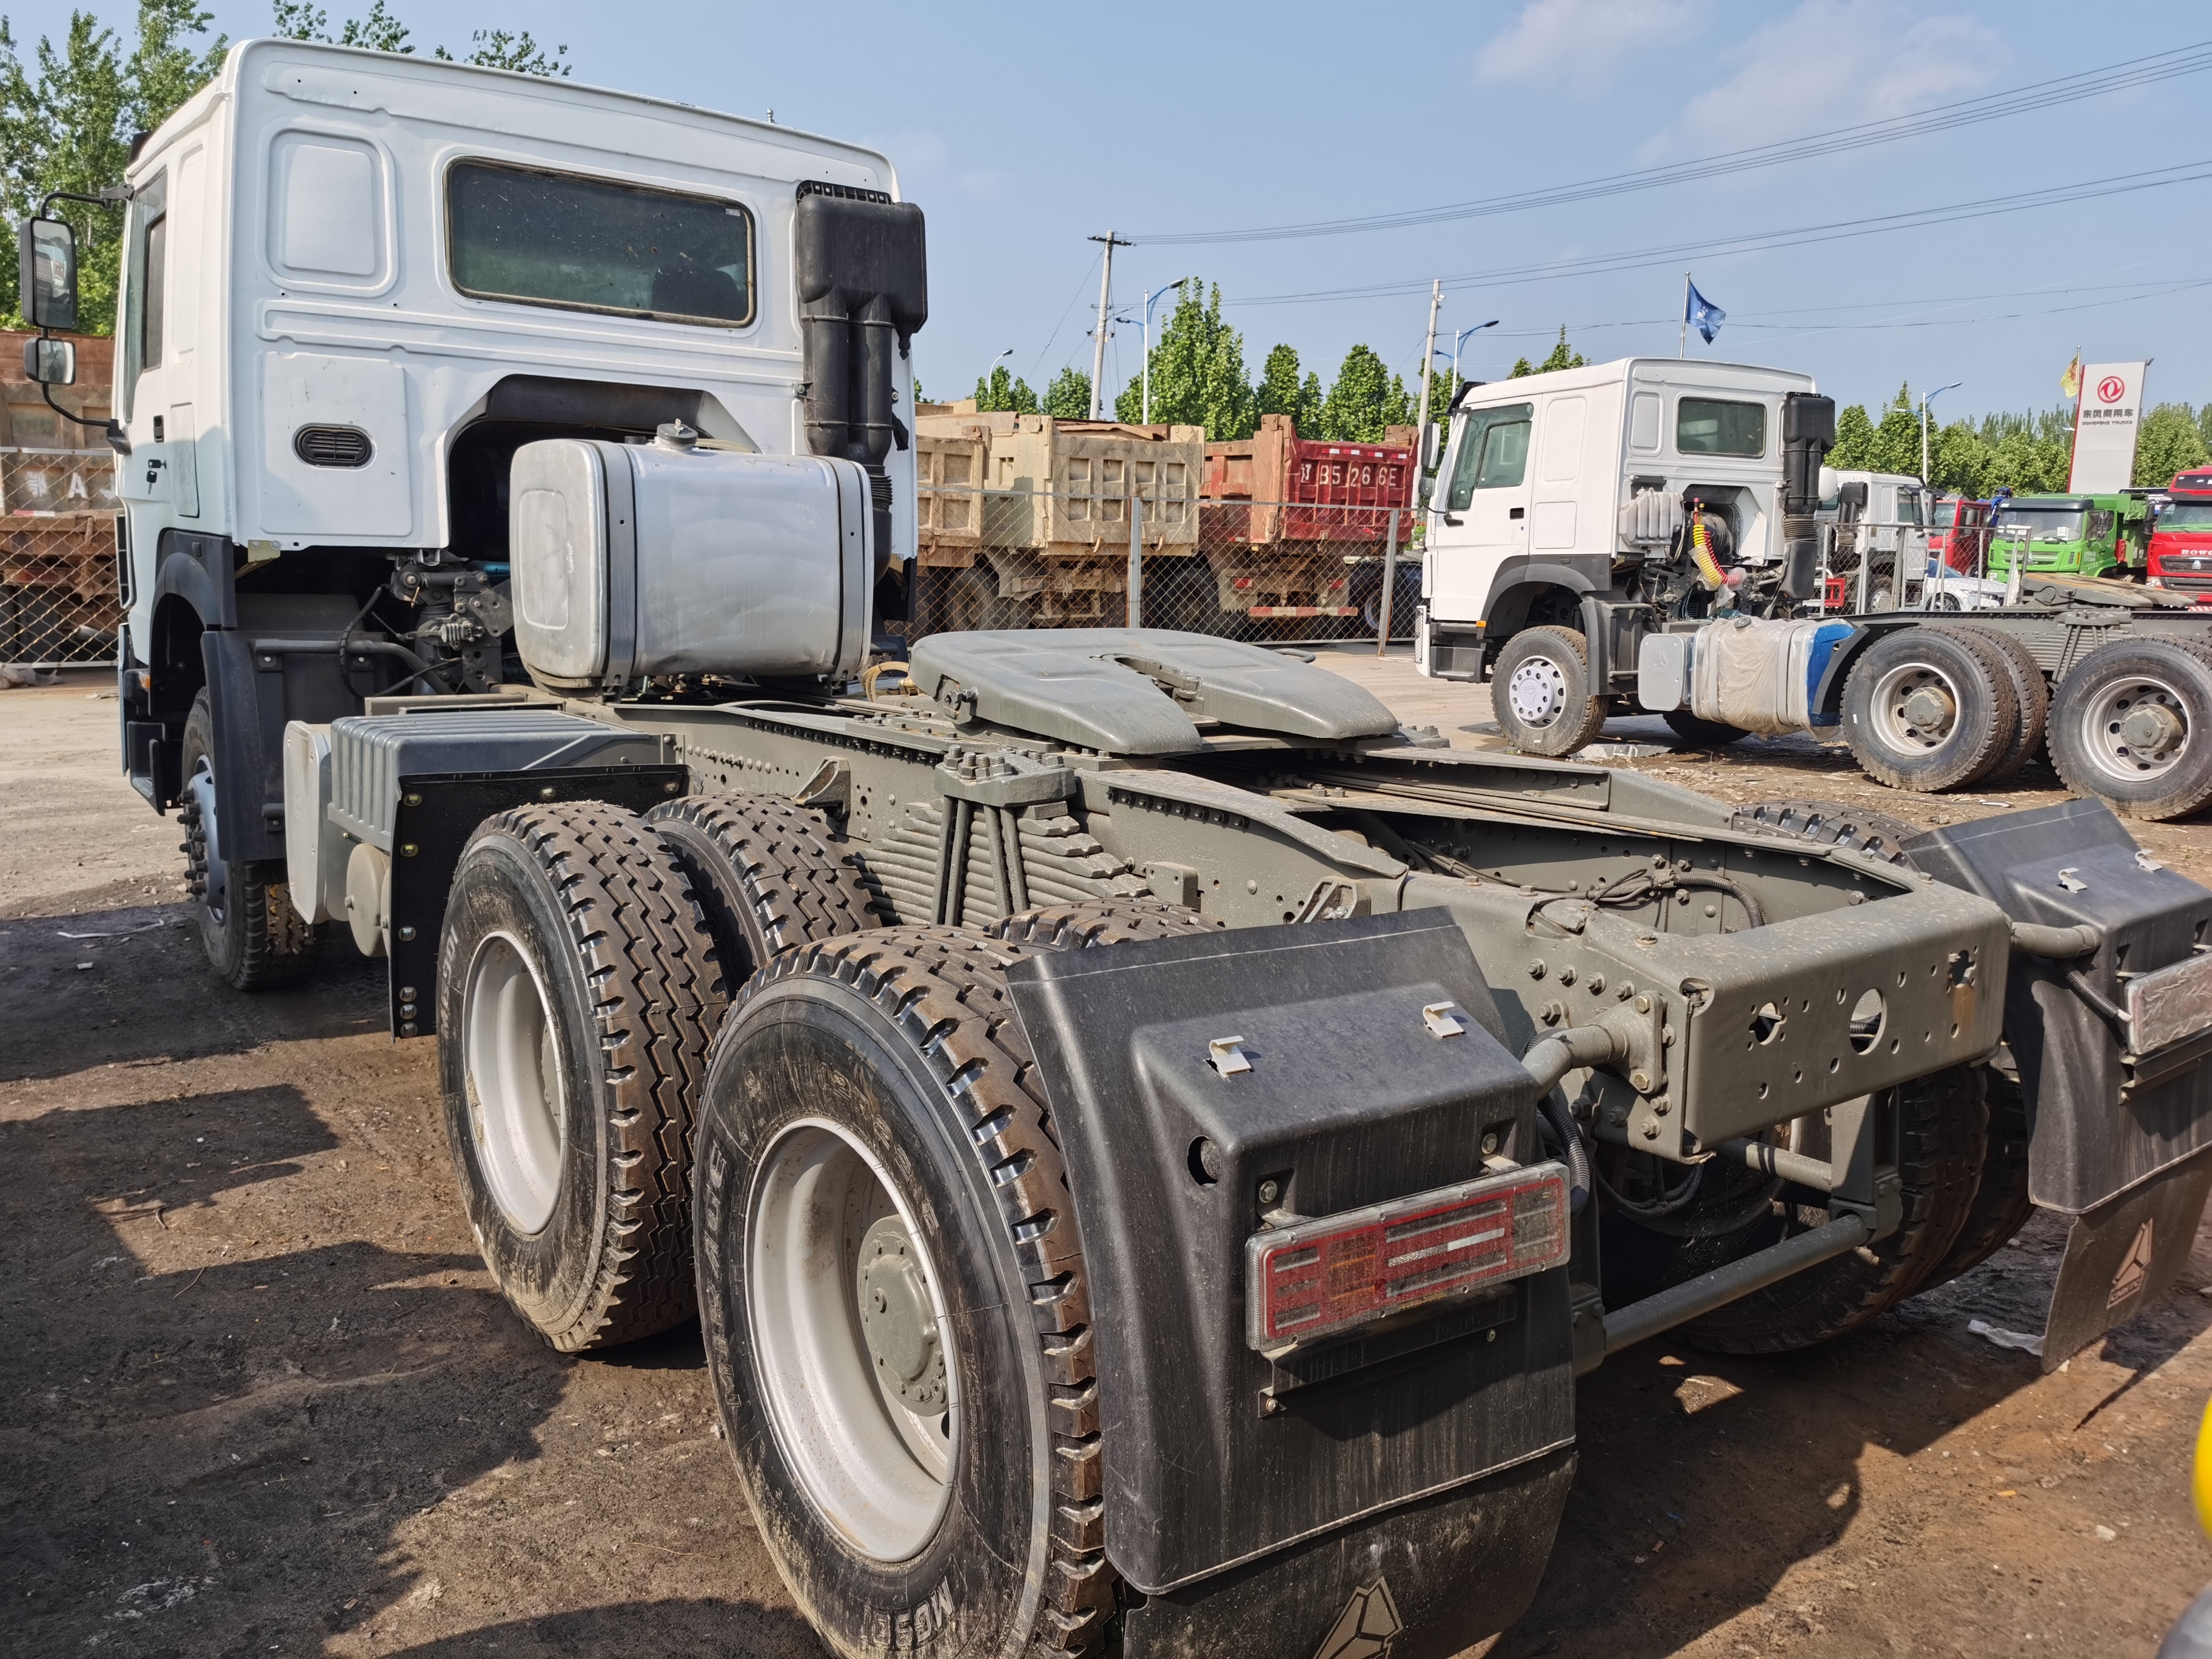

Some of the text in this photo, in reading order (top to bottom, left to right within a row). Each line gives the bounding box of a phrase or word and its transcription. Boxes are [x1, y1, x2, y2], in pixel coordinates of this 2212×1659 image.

[2082, 408, 2134, 418] 东风商用车
